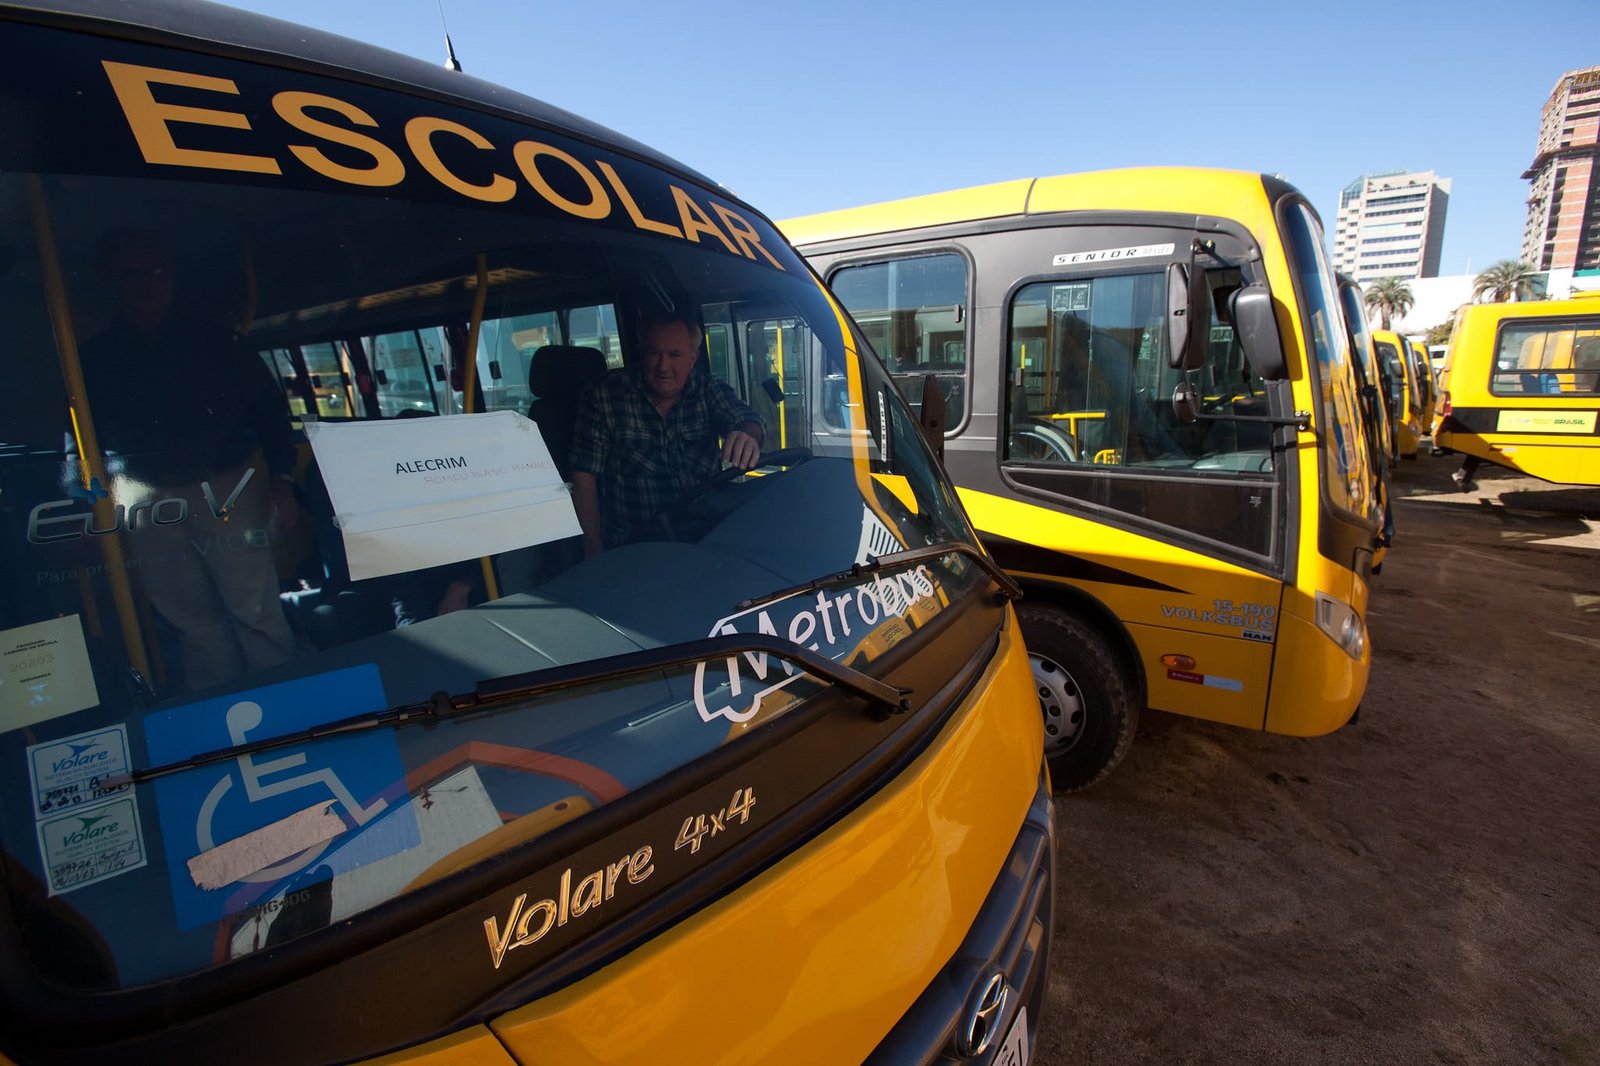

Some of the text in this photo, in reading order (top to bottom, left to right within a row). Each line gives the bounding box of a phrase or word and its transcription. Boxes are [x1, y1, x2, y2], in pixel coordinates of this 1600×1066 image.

[101, 60, 785, 271] ESCOLAR
[1057, 249, 1138, 263] SENIOR
[395, 456, 468, 475] ALECRIM
[26, 467, 256, 544] Euro V
[36, 569, 79, 585] Para
[721, 565, 934, 697] Metrobus
[1161, 606, 1274, 631] VOLKSBUS
[1243, 631, 1272, 641] MAN
[52, 750, 109, 773] Volare
[63, 821, 119, 847] Volare
[483, 787, 756, 969] Volare 4x4
